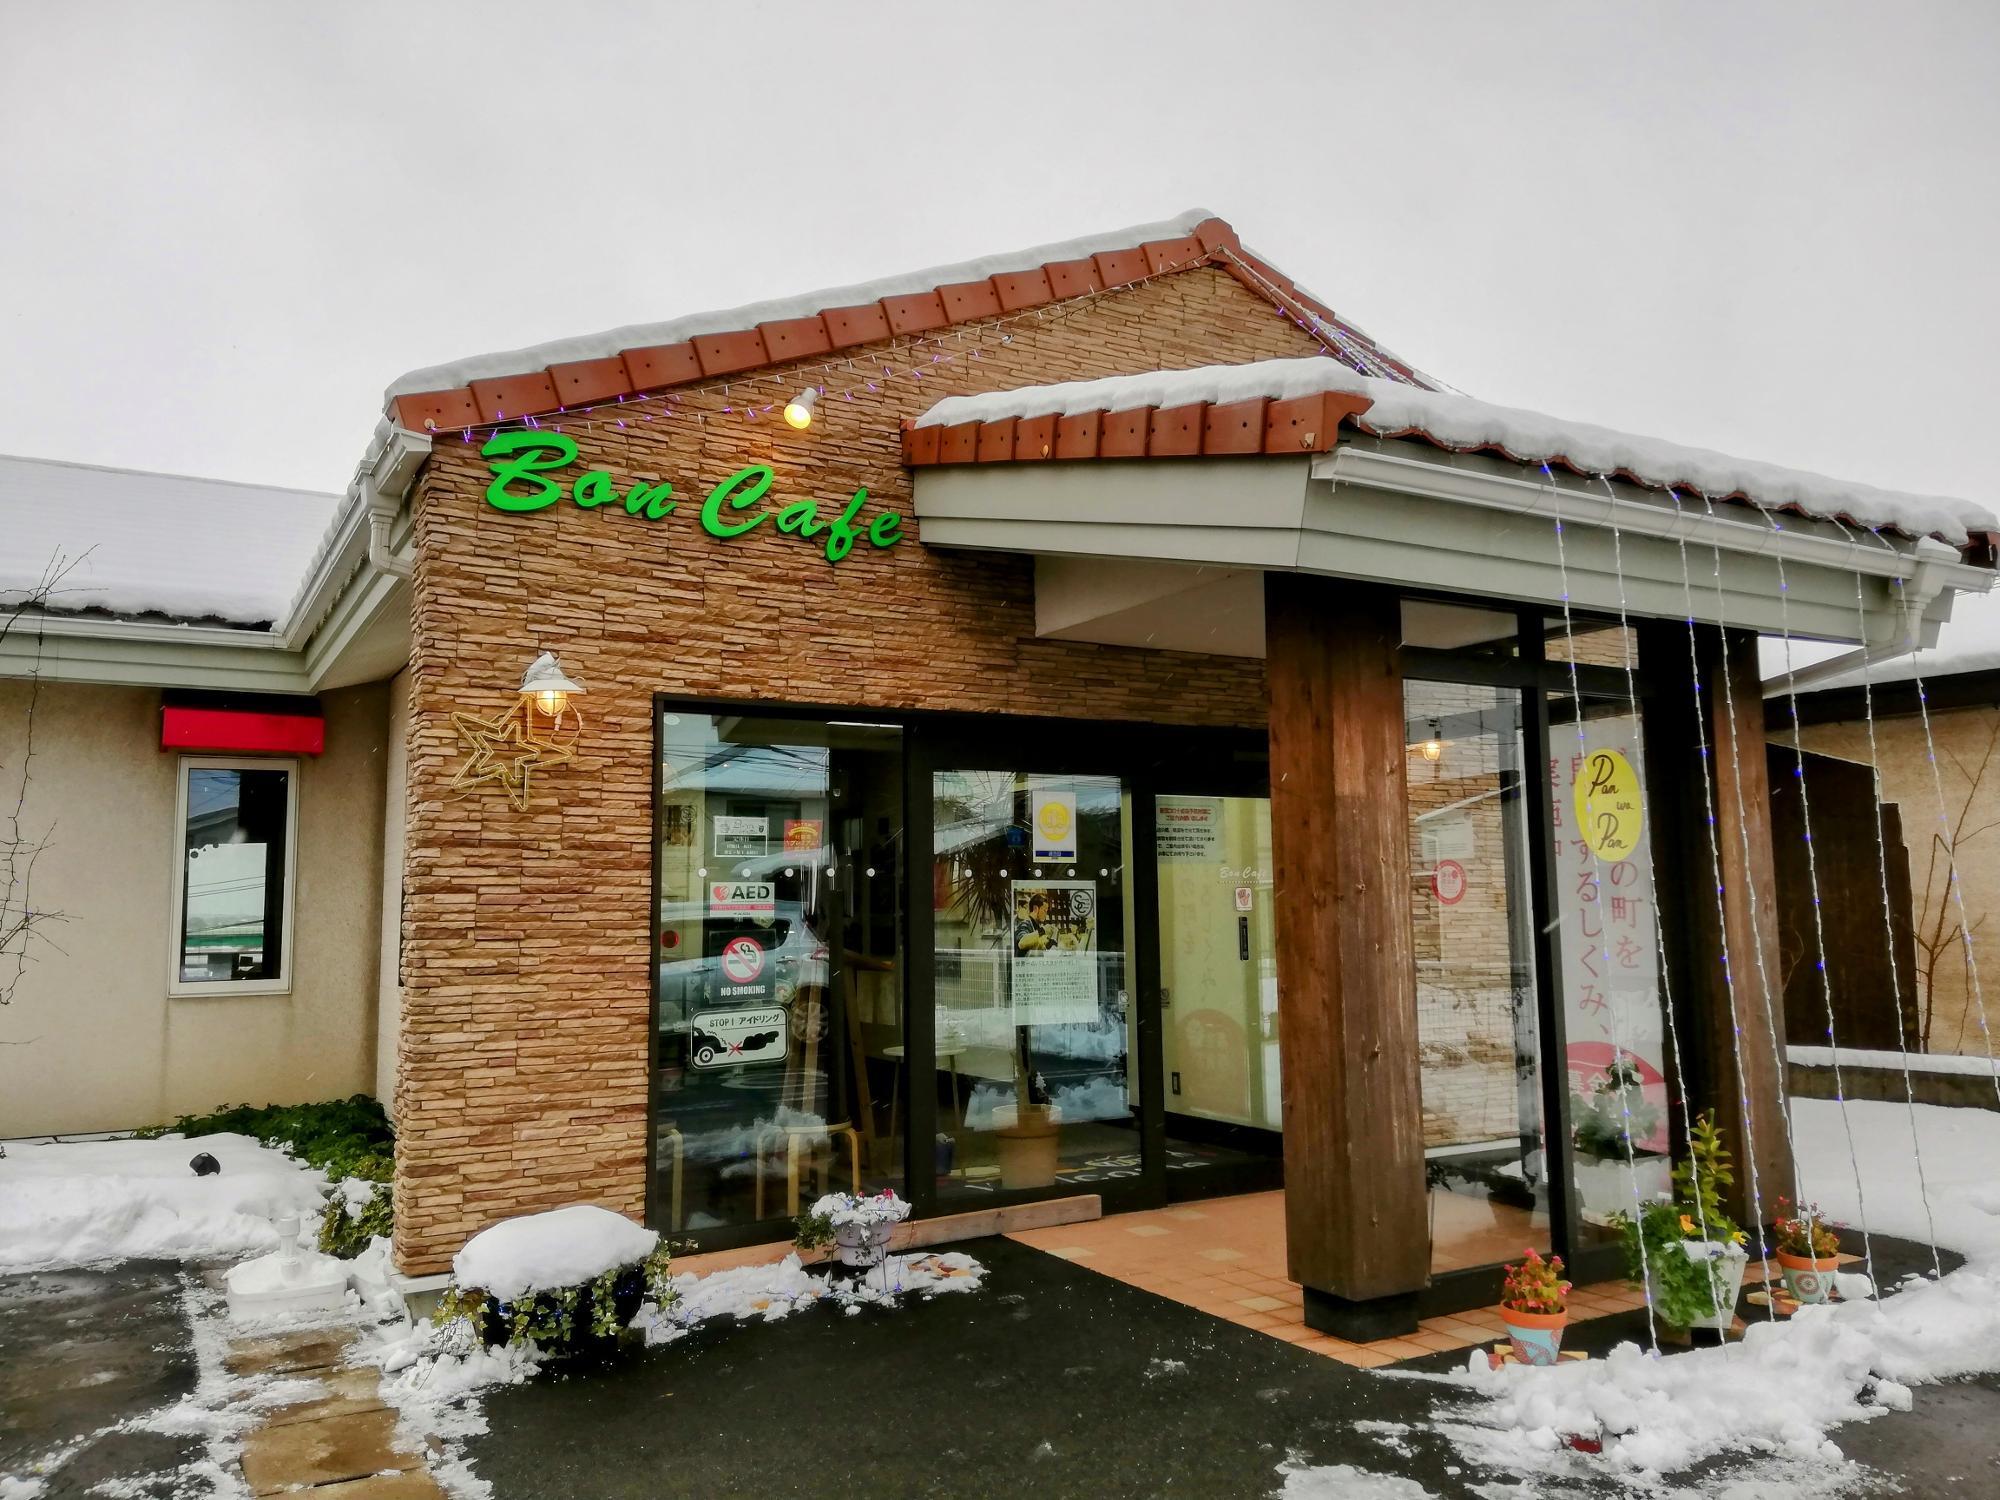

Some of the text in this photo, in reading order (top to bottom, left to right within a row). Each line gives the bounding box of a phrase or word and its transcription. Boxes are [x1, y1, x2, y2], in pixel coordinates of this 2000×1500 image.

[480, 430, 905, 563] Bon Cafe
[1588, 754, 1619, 797] Pan
[1597, 812, 1628, 851] Pan
[731, 885, 770, 900] AED
[720, 985, 766, 997] NO SMOKING
[739, 1013, 780, 1025] アイドリング
